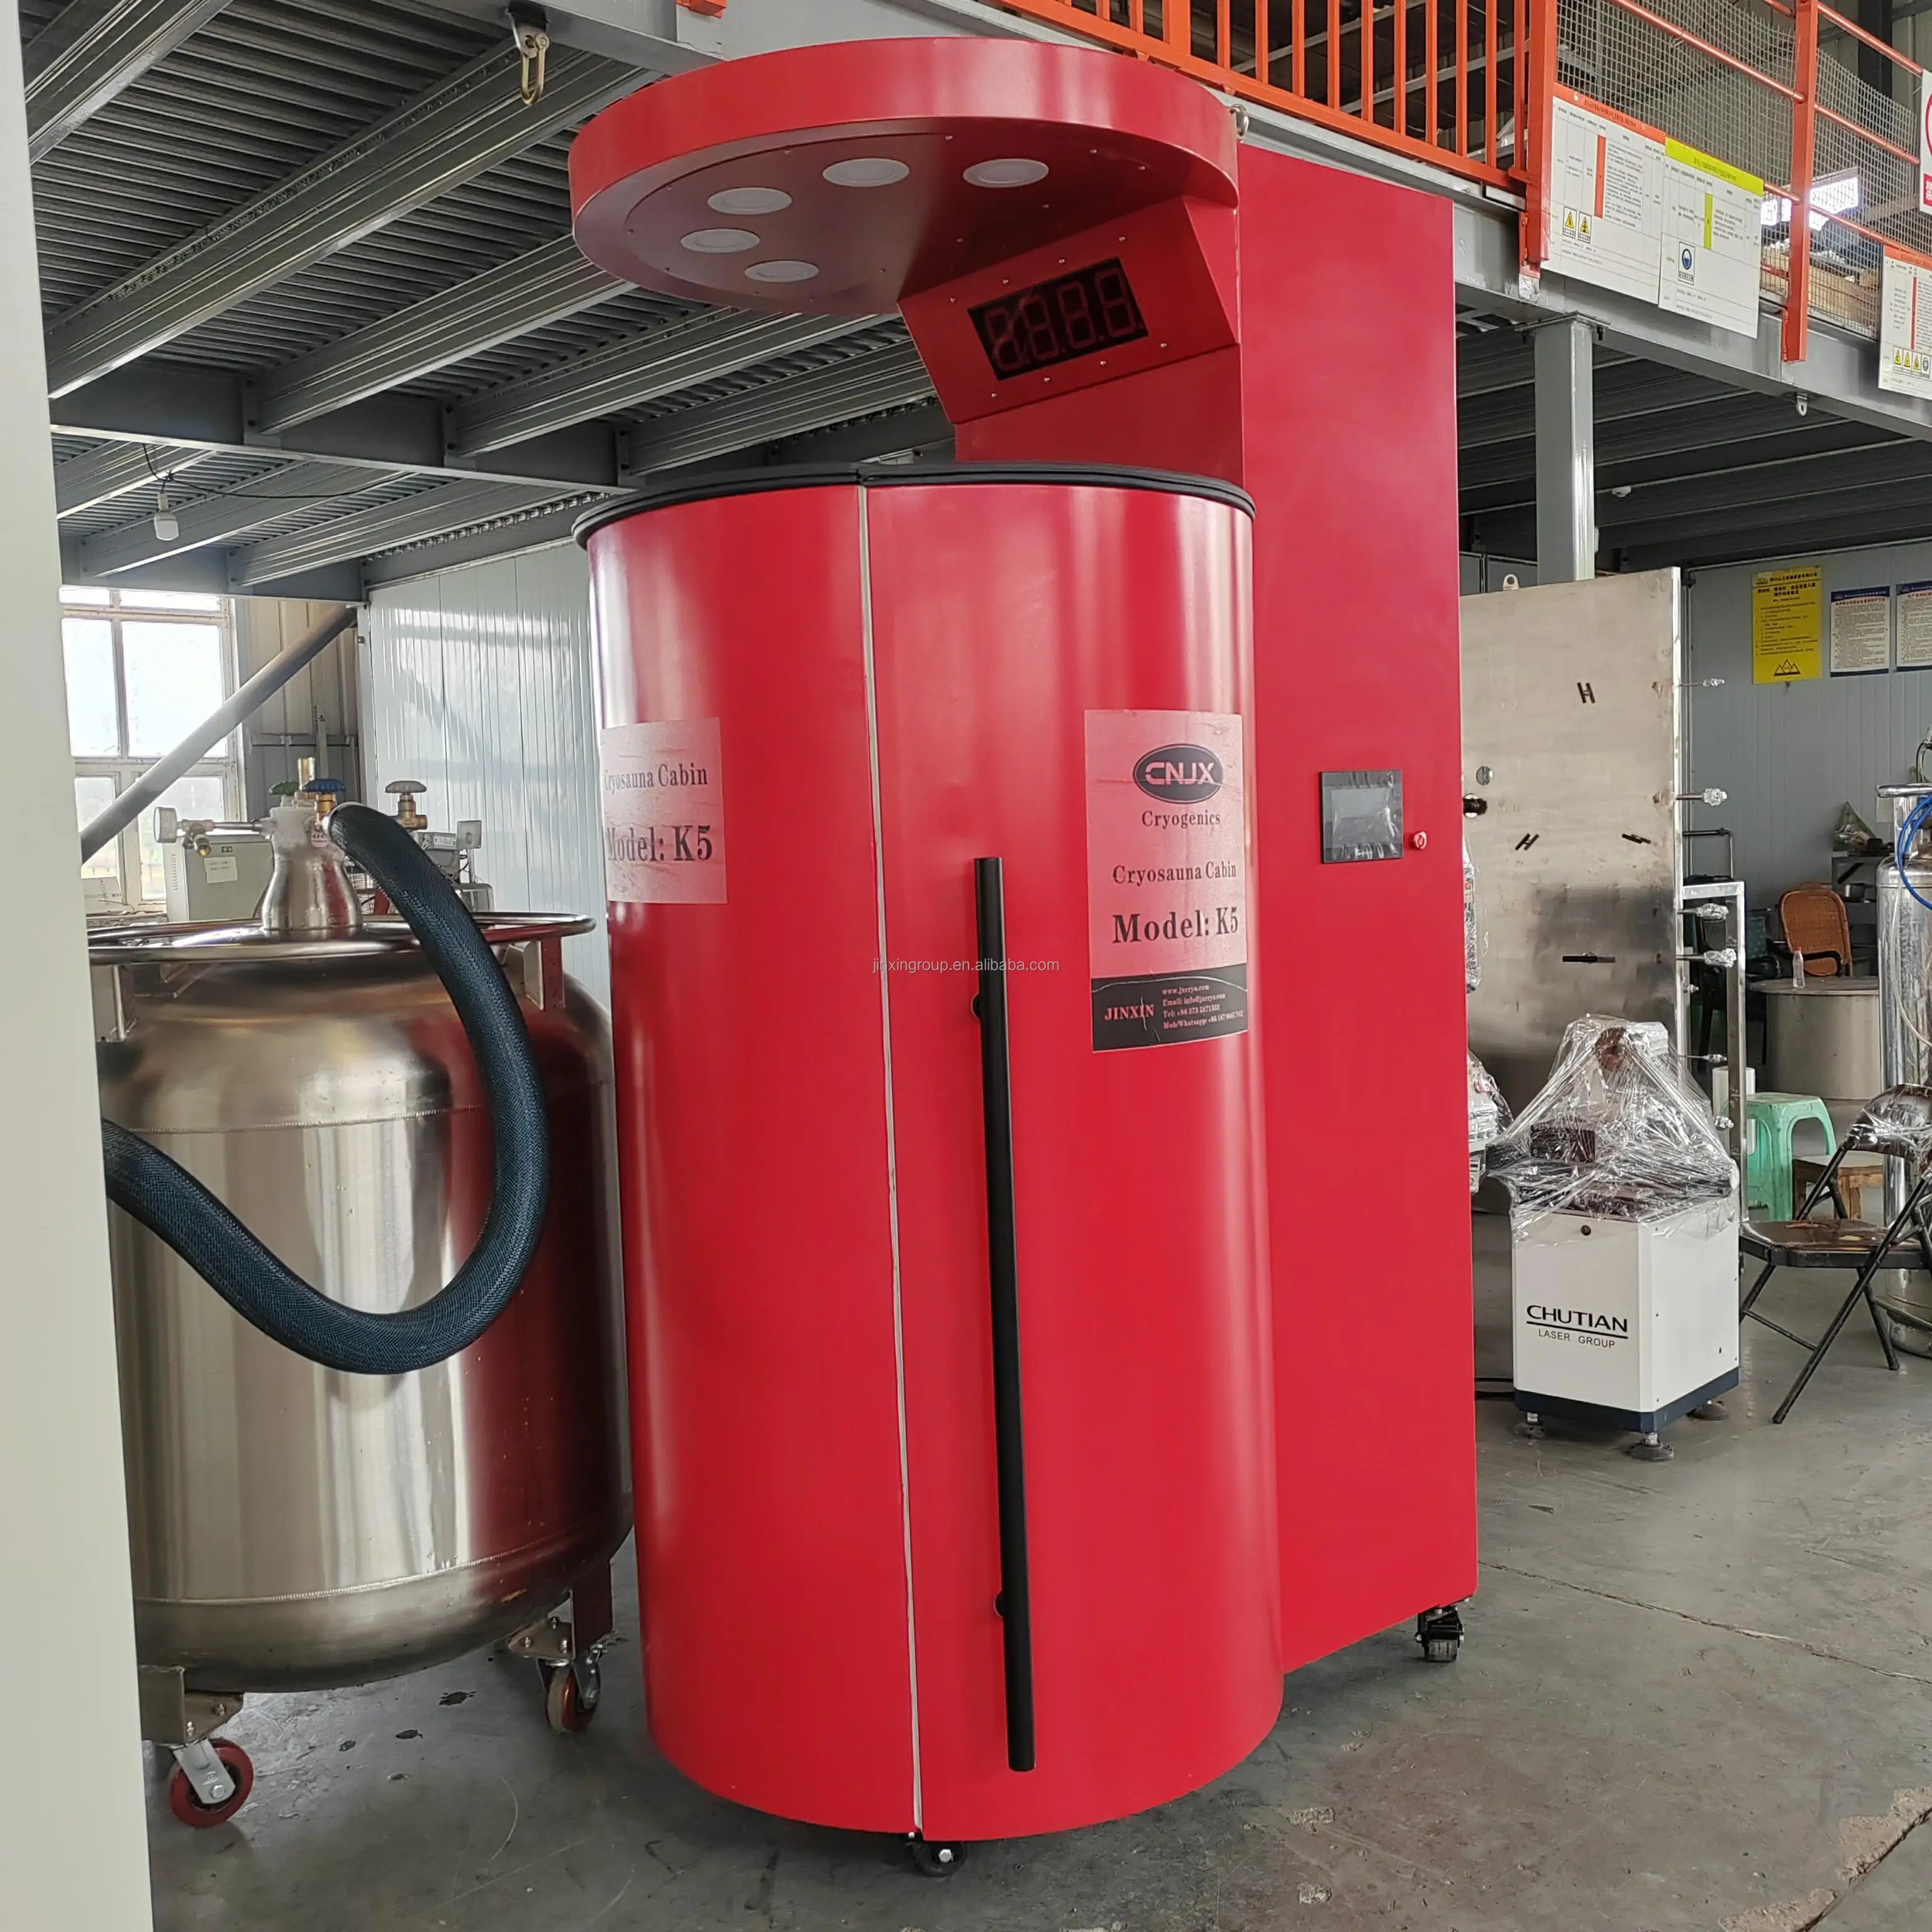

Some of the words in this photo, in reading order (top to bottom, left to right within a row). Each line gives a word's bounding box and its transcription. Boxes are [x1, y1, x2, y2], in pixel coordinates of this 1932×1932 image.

[604, 769, 654, 794] Cryosauna
[658, 762, 708, 787] Cabin
[1141, 810, 1221, 829] Cryogenics
[607, 826, 665, 862] Model:
[673, 825, 713, 862] K5
[1113, 865, 1202, 887] Cryosauna
[1206, 860, 1237, 879] Cabin
[1112, 909, 1209, 943] Model:
[1216, 906, 1239, 935] K5
[1104, 1004, 1155, 1021] JINXIN
[1526, 1305, 1628, 1333] CHUTIAN
[1538, 1330, 1570, 1341] LASER
[1578, 1336, 1615, 1348] GROUP
